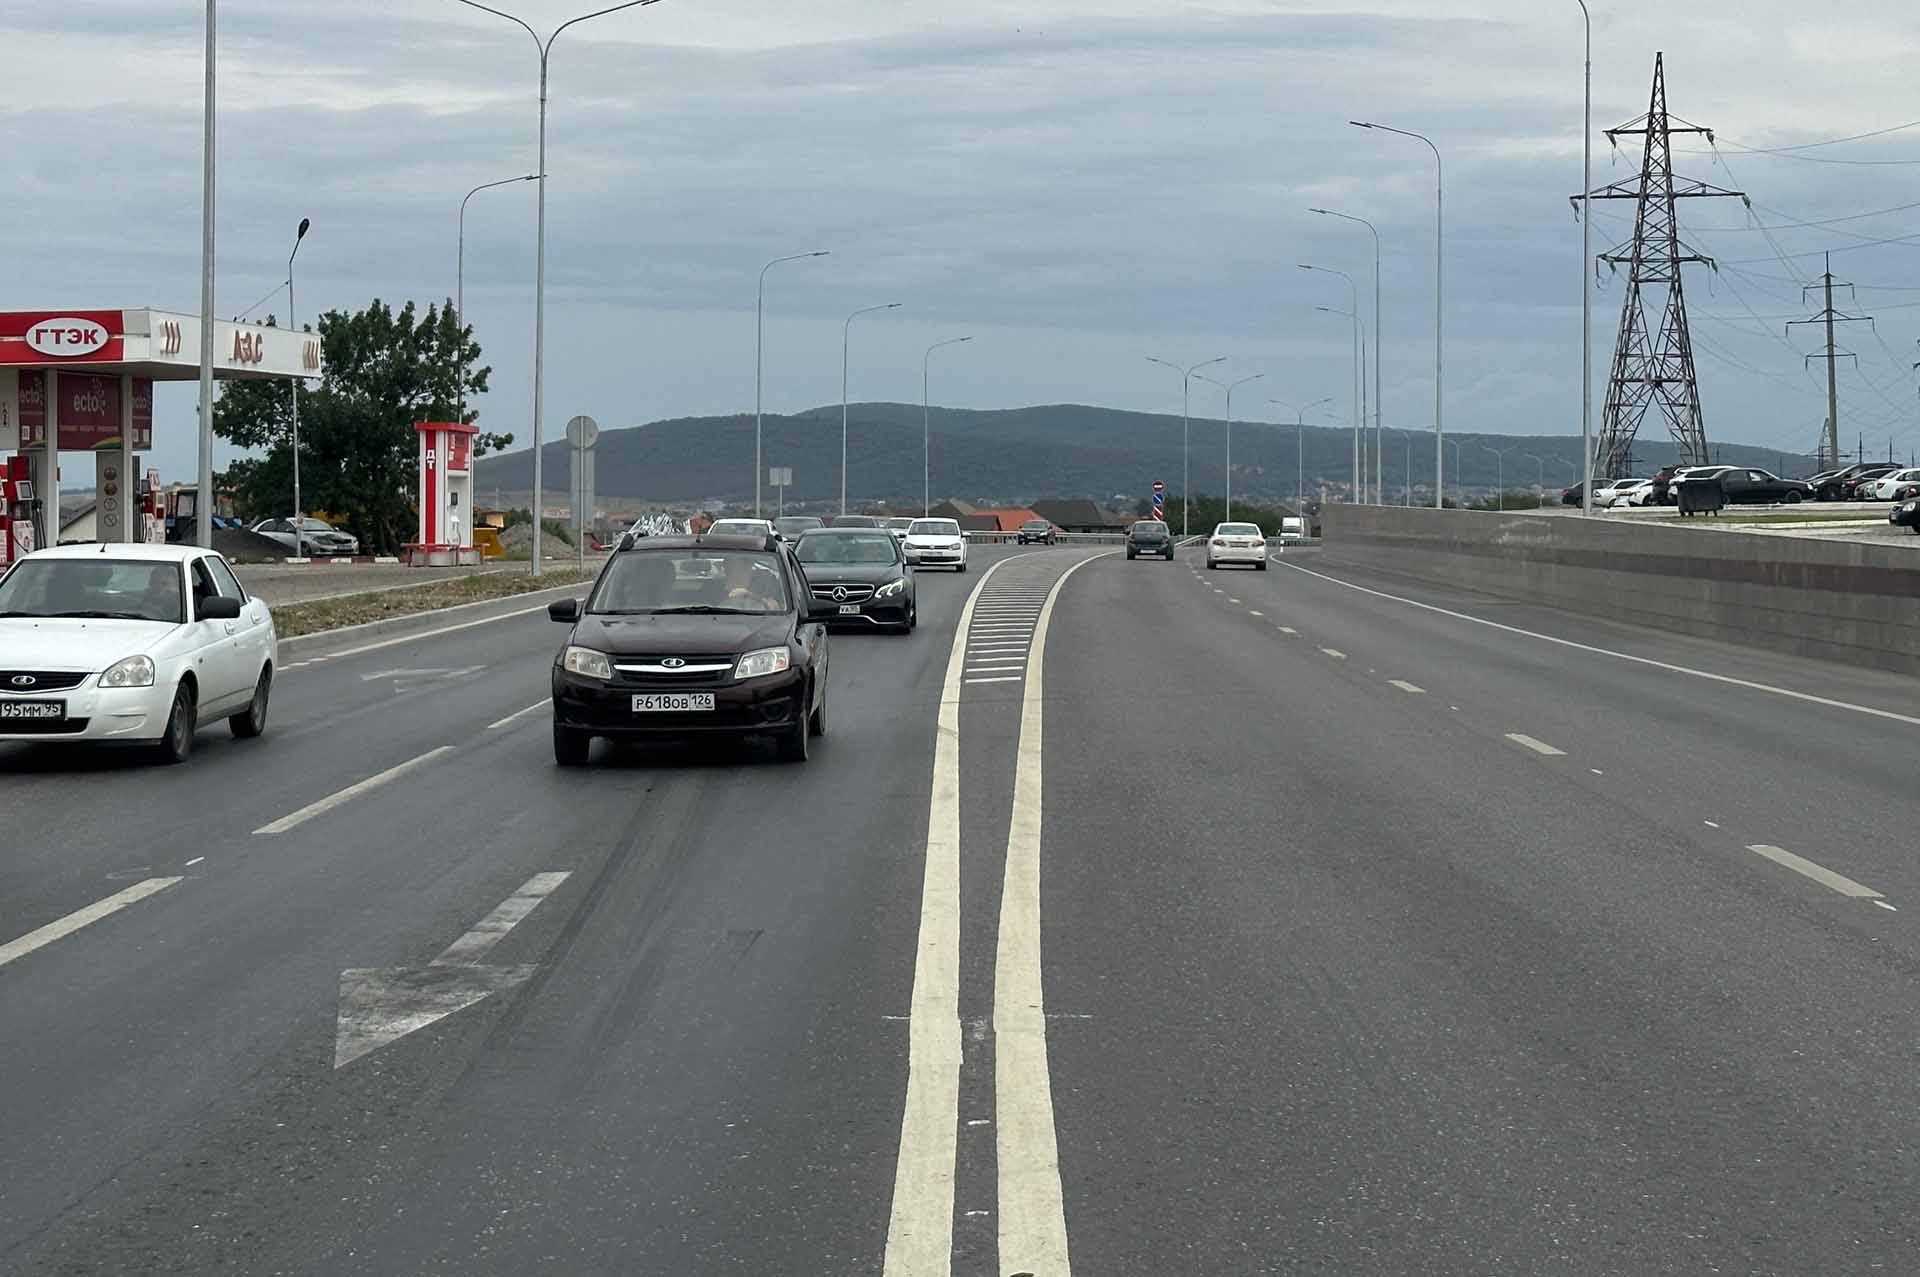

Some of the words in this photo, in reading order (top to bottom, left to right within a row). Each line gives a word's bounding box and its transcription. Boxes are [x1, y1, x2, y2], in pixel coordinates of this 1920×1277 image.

[35, 328, 98, 345] ГТЭК
[233, 330, 263, 364] АЗС
[73, 391, 98, 412] ecto
[0, 703, 42, 717] 95ММ
[45, 703, 59, 713] 95
[636, 695, 689, 709] Р618ОВ
[691, 695, 711, 705] 126
